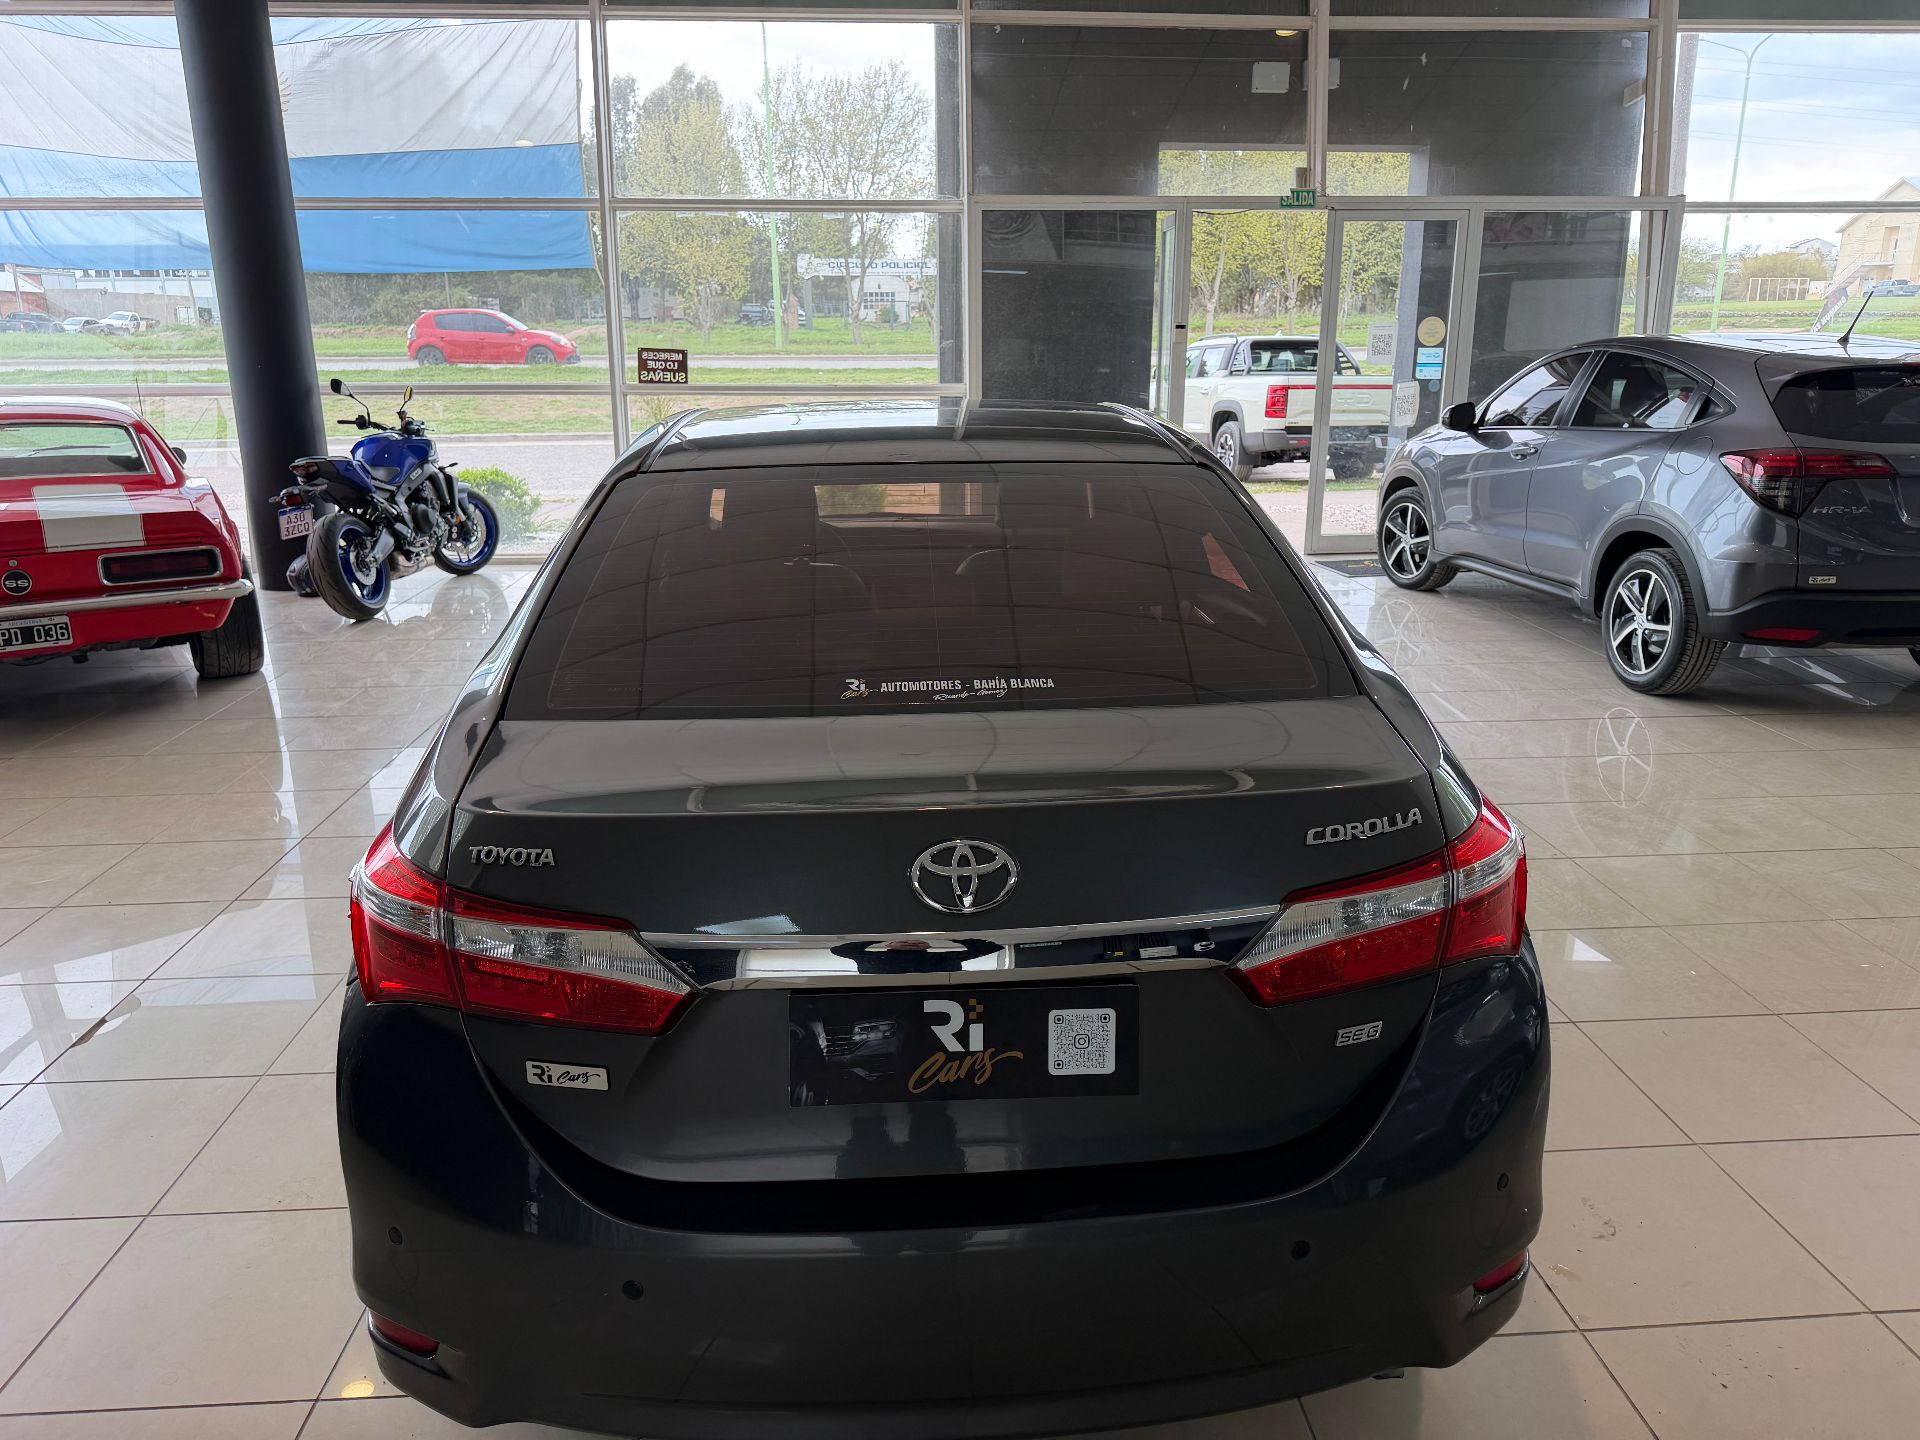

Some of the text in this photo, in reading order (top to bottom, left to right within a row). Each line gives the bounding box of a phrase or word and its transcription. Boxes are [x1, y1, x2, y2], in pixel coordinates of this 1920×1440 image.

[1281, 191, 1314, 206] SALIDA
[828, 261, 878, 269] CIRCUO
[1813, 505, 1871, 514] HR-V
[4, 579, 29, 588] SS
[33, 623, 69, 642] 036
[880, 679, 962, 693] AUTOMOTORES
[973, 676, 1008, 690] BAHÍA
[1009, 678, 1055, 689] BLANCA
[1306, 807, 1423, 845] COROLLA
[468, 845, 556, 867] TOYOTA
[923, 998, 984, 1053] Ri
[531, 1063, 601, 1085] Ri Cars
[908, 1047, 1024, 1094] Cars
